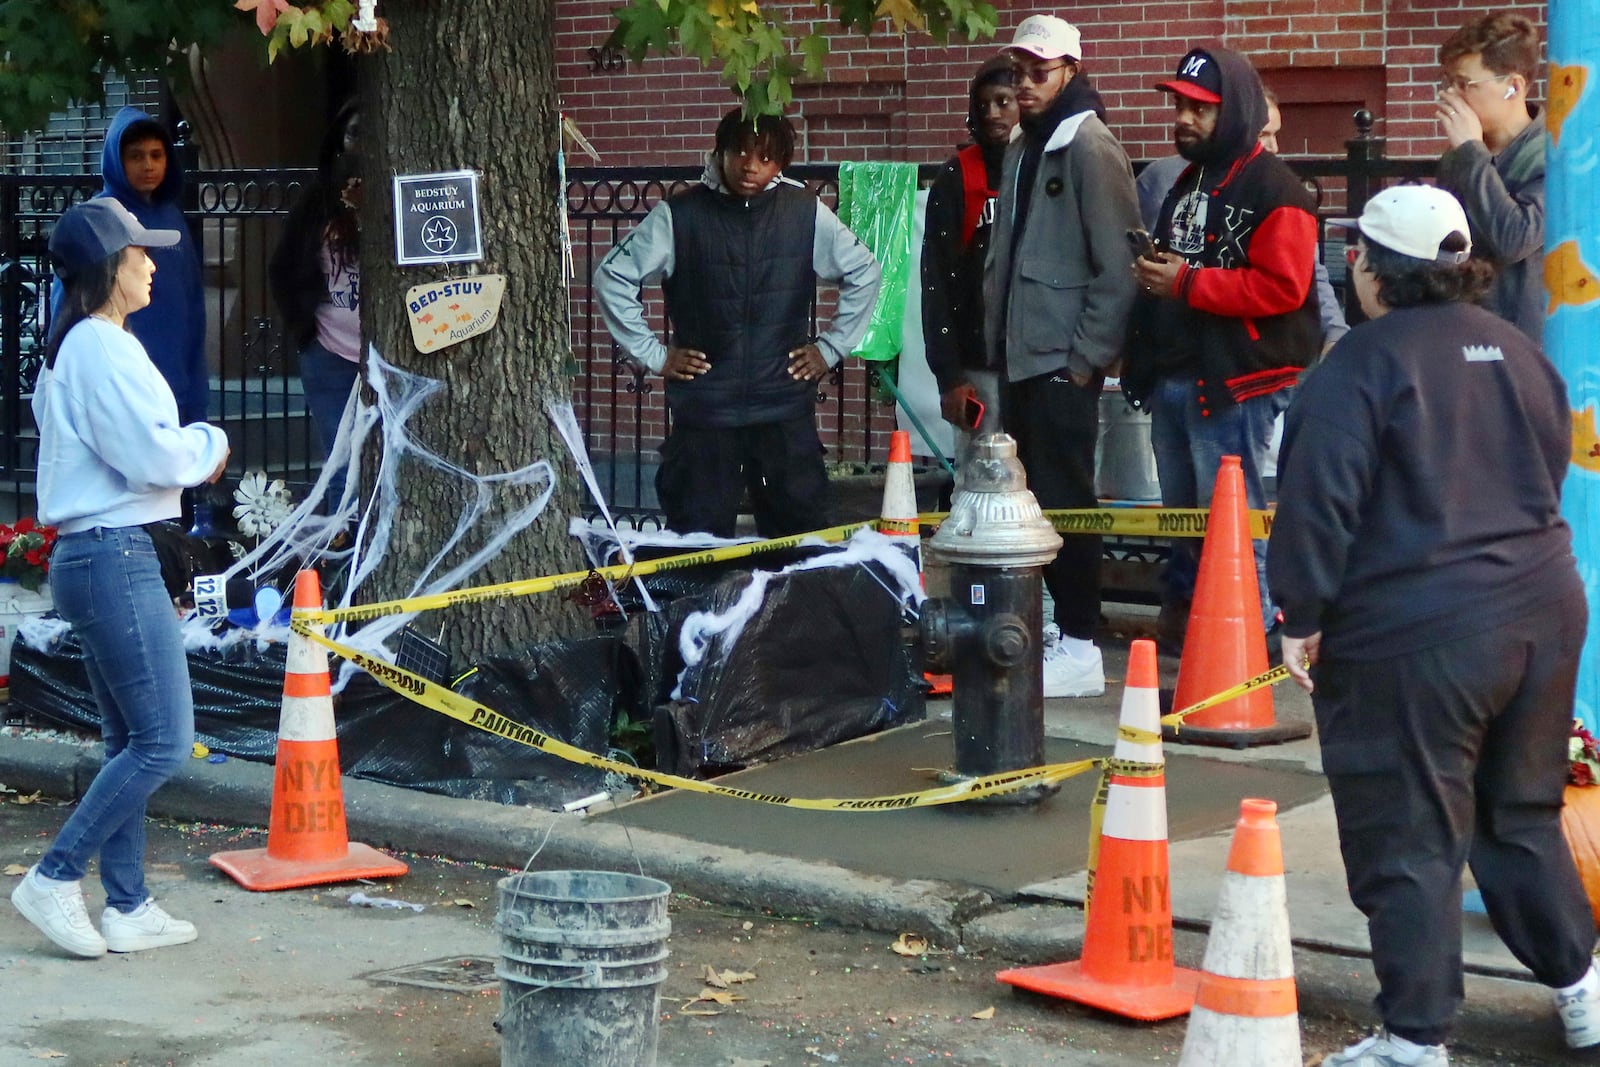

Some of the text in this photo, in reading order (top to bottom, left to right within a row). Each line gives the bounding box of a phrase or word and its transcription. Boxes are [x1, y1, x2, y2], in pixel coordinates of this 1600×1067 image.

[1182, 55, 1207, 77] M
[415, 186, 458, 198] BEDSTUY
[410, 199, 466, 213] AQUARIUM
[409, 282, 483, 314] BED-STUY
[449, 308, 492, 340] Aquarium
[198, 598, 218, 617] 12
[469, 708, 547, 747] CAUTION
[284, 799, 341, 832] DEP
